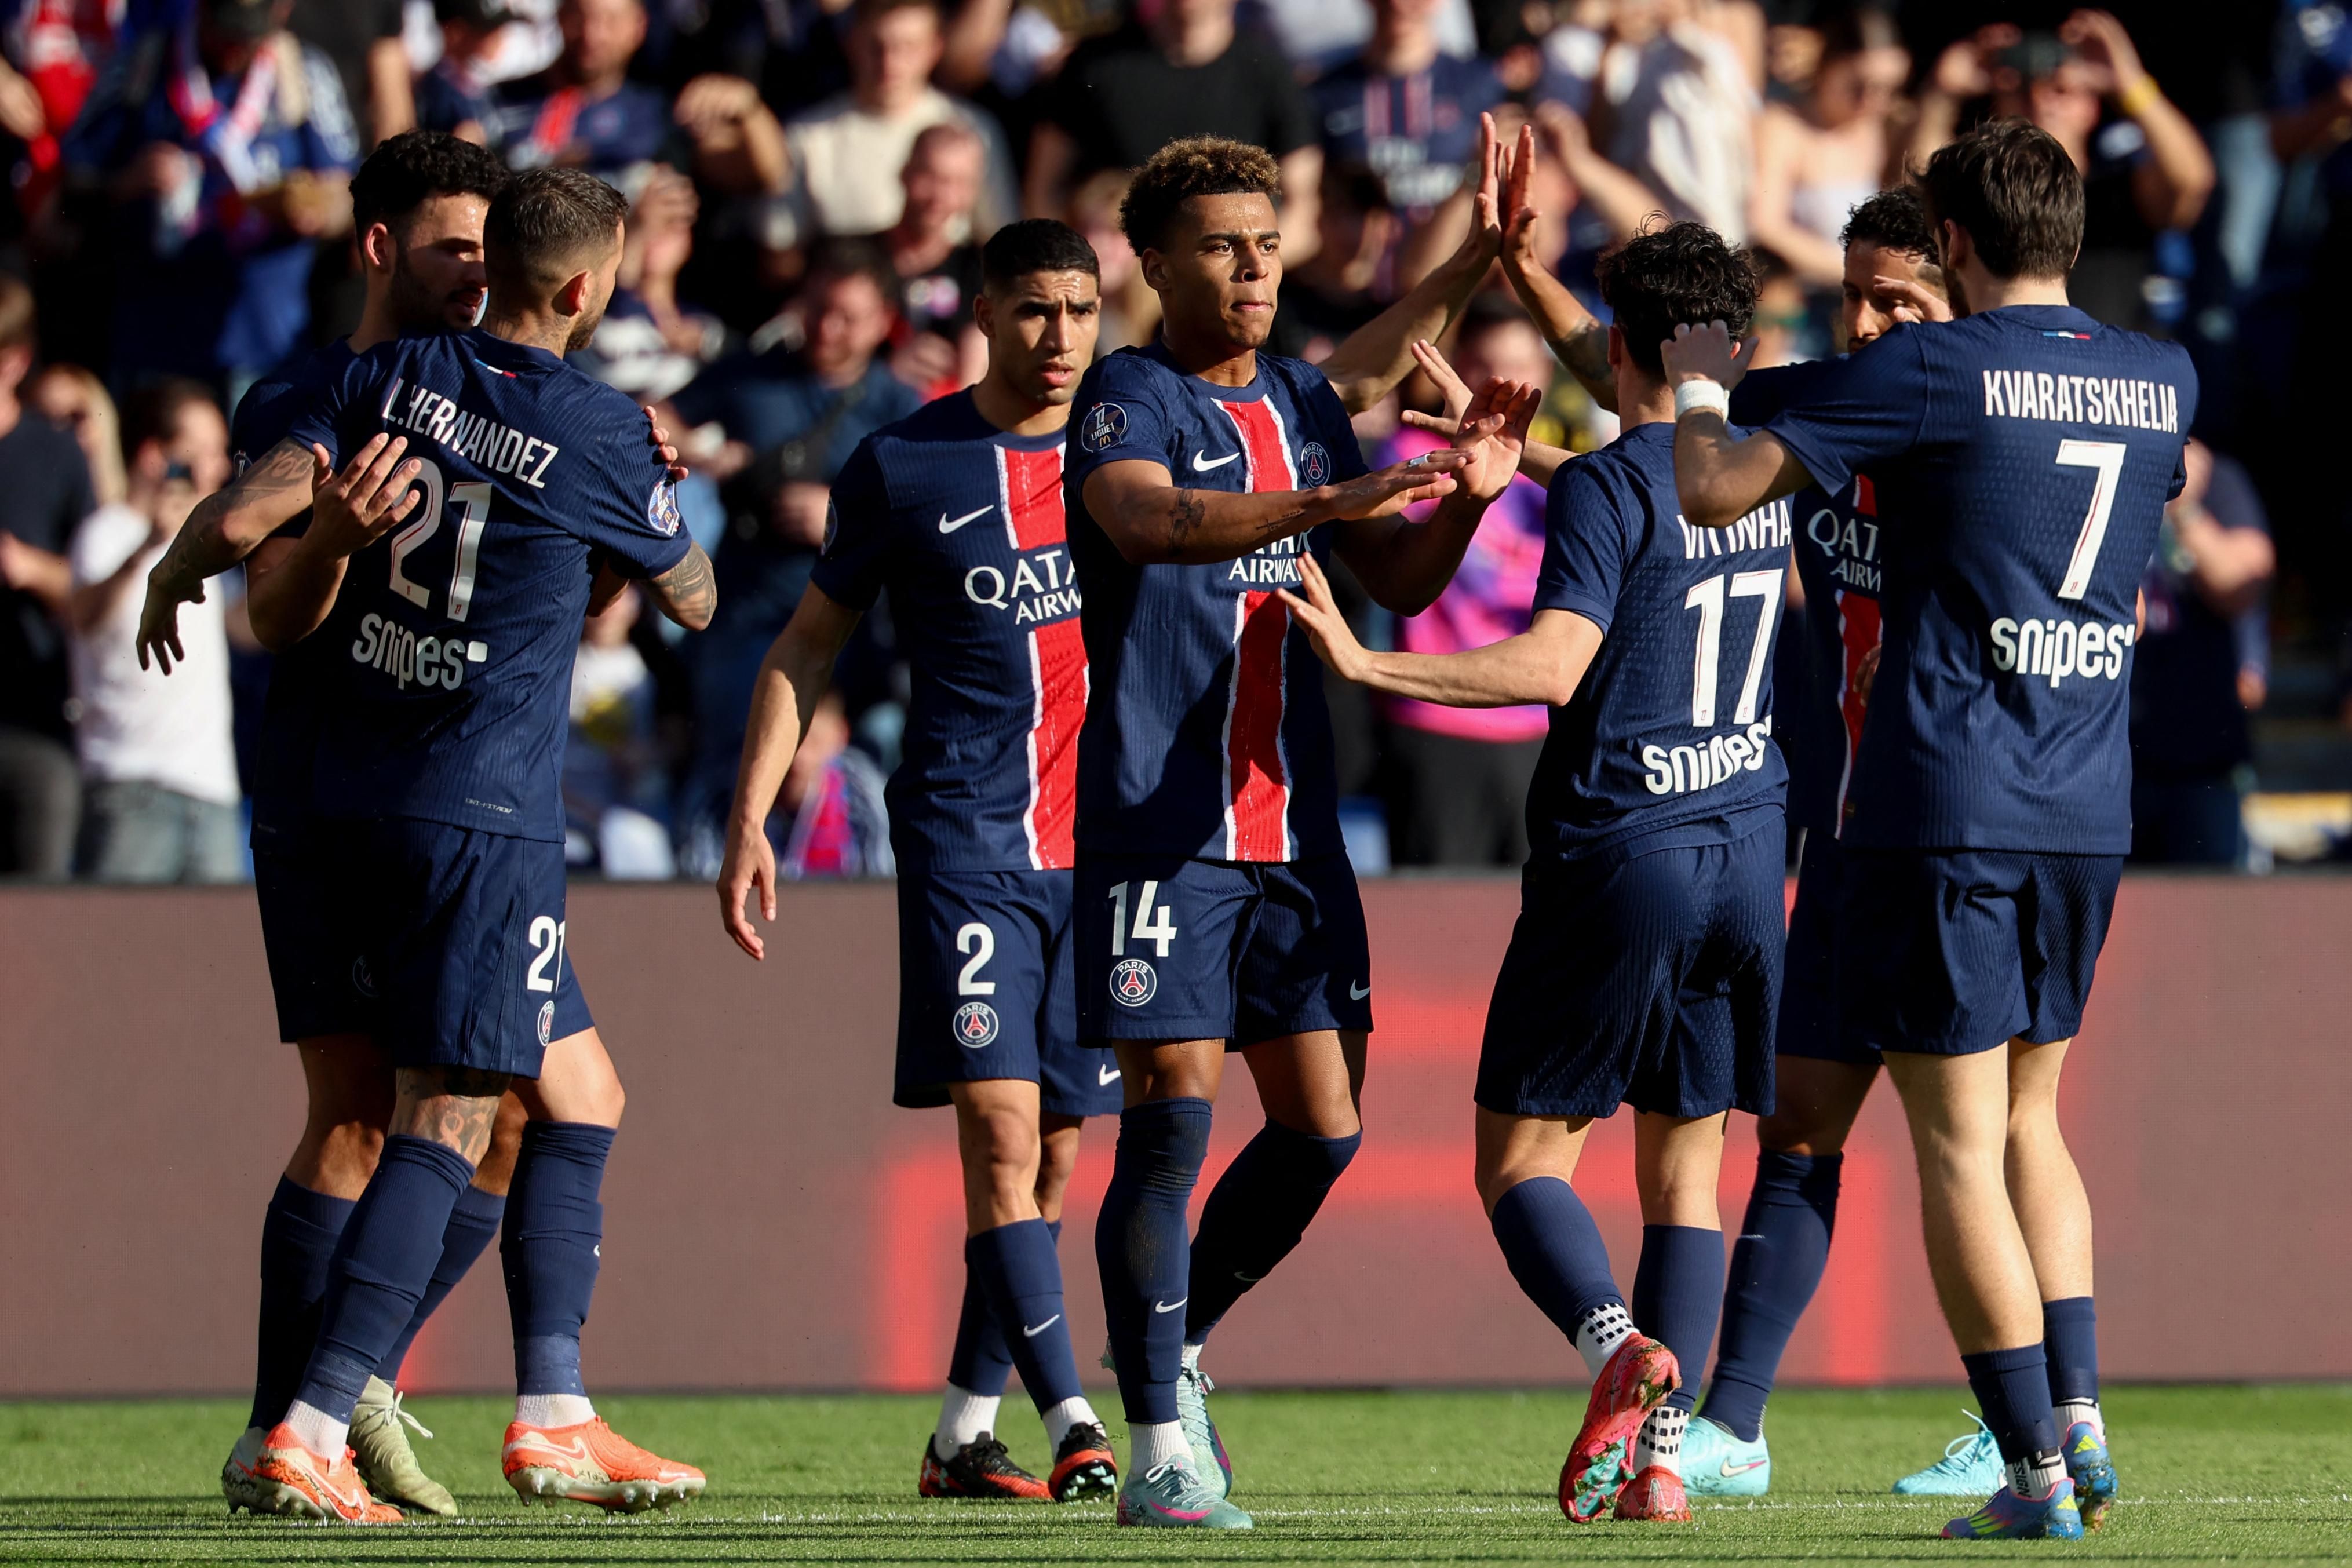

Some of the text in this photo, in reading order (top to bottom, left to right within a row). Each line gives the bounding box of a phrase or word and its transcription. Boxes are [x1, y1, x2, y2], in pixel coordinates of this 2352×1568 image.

[1091, 424, 1111, 440] LIGUE
[1983, 370, 2178, 433] KVARATSKHELIA
[1304, 444, 1323, 456] PARIS
[389, 456, 493, 622] 21
[1807, 508, 1881, 564] QAT
[2055, 439, 2127, 600] 7
[965, 549, 1076, 610] QAT
[1015, 588, 1082, 625] AIRW
[1684, 568, 1784, 727] 17
[1108, 880, 1177, 957] 14
[527, 916, 566, 994] 21
[957, 922, 995, 996] 2
[1117, 962, 1148, 973] PARIS
[960, 1004, 990, 1017] PARIS
